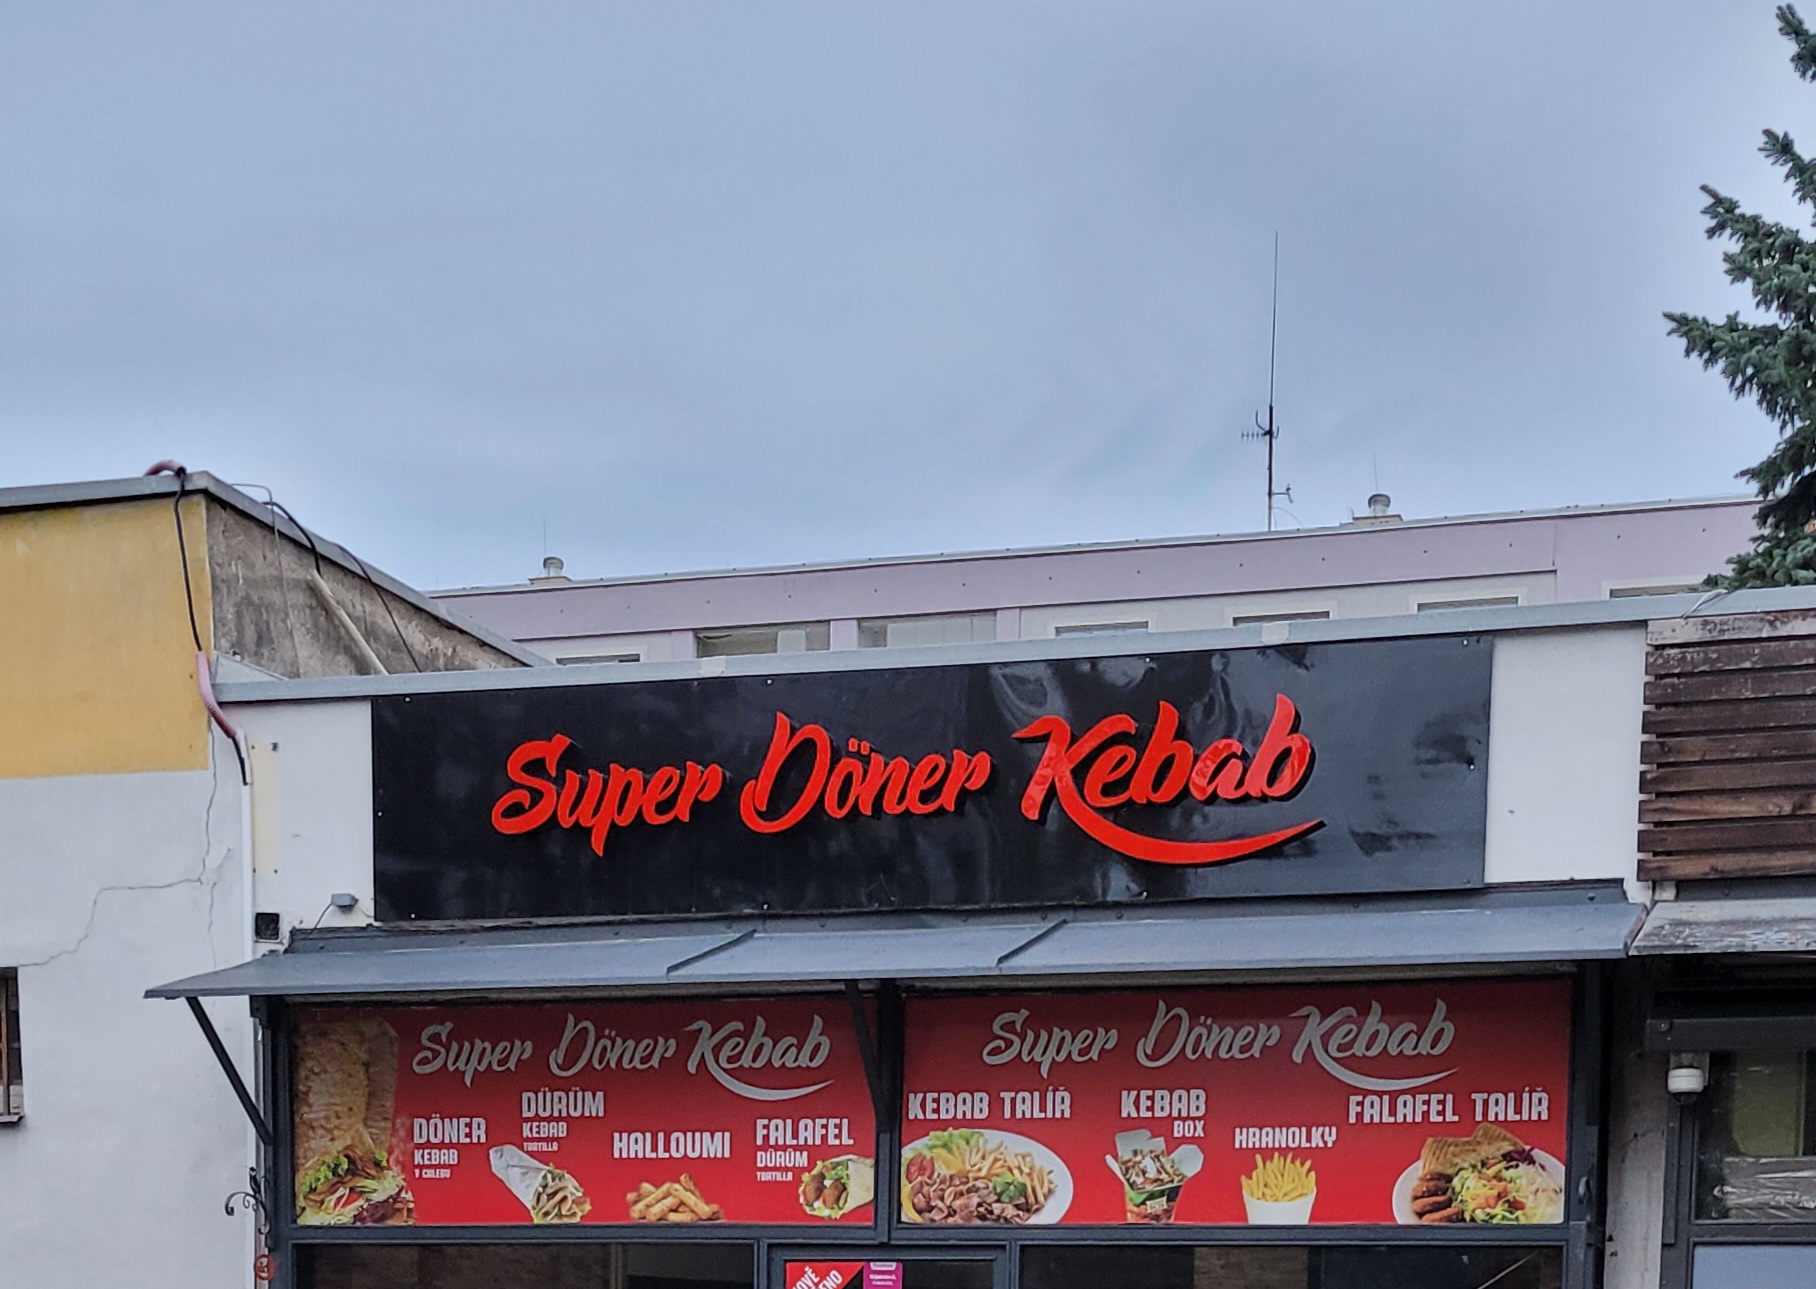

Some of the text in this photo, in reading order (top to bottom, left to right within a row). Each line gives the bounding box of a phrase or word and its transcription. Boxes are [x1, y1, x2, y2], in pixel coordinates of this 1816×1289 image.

[491, 692, 1326, 865] Super Döner Kebab
[411, 1013, 834, 1101] Super Döner Kebab
[982, 1000, 1460, 1091] Super Döner Kebab
[521, 1087, 605, 1118] DÜRÜM
[908, 1091, 990, 1121] KEBAB
[1120, 1089, 1206, 1118] KEBAB
[1348, 1094, 1459, 1124] FALAFEL
[413, 1114, 487, 1144] DÖNER
[522, 1121, 567, 1138] KEBAB
[756, 1118, 855, 1146] FALAFEL
[1173, 1120, 1205, 1137] BOX
[1234, 1125, 1338, 1149] HRANOLKY
[414, 1149, 458, 1165] KEBAB
[613, 1131, 731, 1160] HALLOUMI
[756, 1148, 808, 1168] DÜRÜM
[756, 1171, 793, 1181] TORTILLA
